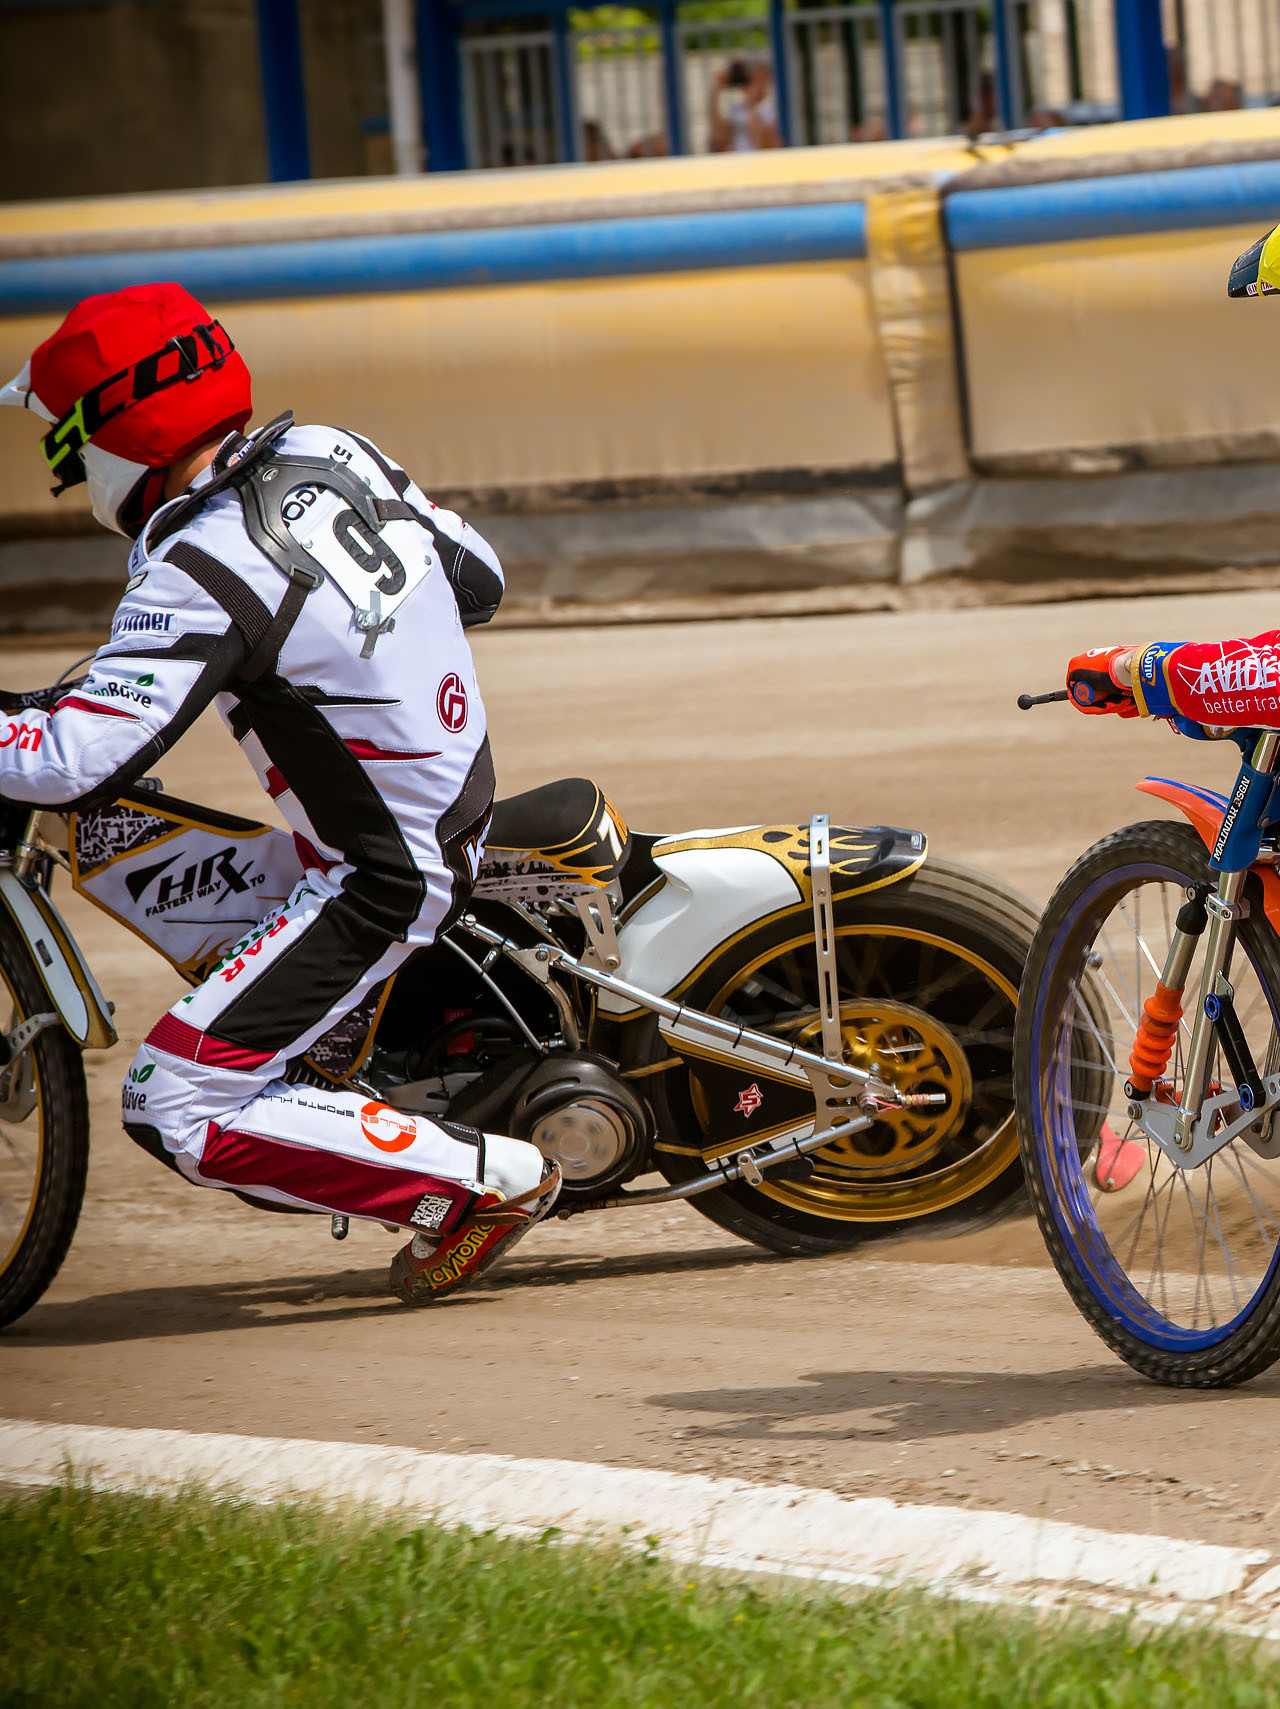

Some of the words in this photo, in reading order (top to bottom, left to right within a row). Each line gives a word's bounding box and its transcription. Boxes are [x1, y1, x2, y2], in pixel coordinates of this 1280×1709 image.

[333, 509, 407, 595] 9
[1202, 697, 1251, 714] better
[145, 892, 194, 918] FASTEST
[196, 880, 222, 899] WAY
[250, 873, 266, 888] TO
